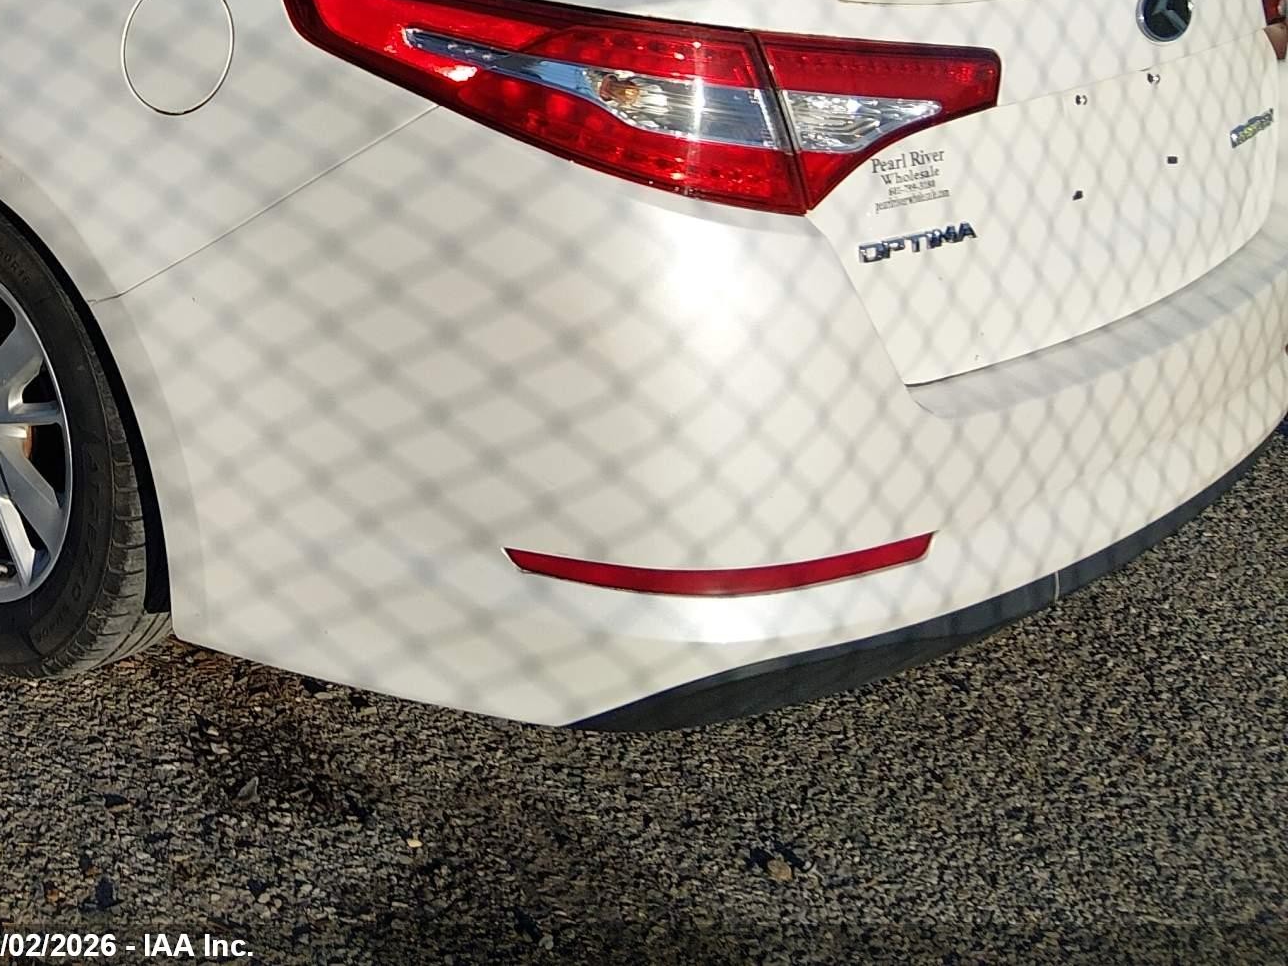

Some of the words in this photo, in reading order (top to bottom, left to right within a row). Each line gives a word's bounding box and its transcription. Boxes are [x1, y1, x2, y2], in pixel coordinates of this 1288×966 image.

[872, 153, 907, 174] Pearl
[909, 150, 945, 167] River
[880, 166, 940, 185] Wholesale
[858, 222, 977, 264] OPTIMA
